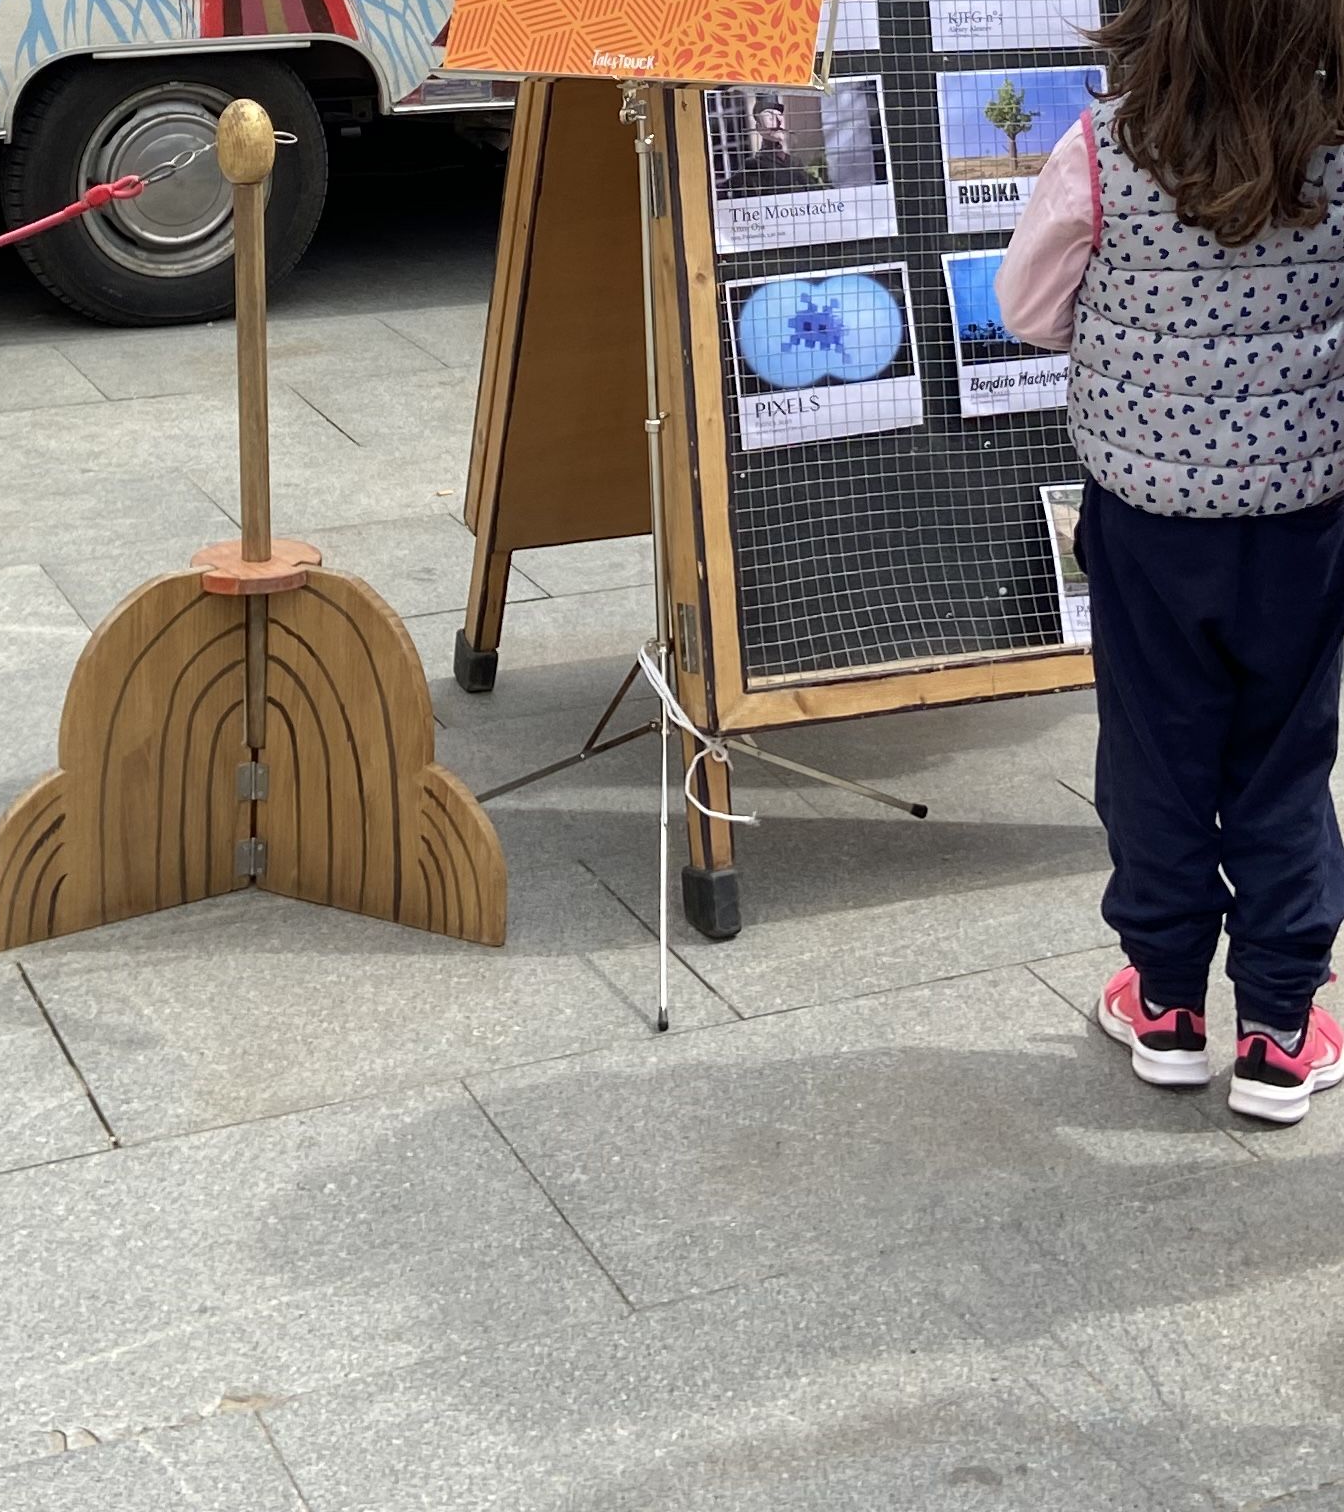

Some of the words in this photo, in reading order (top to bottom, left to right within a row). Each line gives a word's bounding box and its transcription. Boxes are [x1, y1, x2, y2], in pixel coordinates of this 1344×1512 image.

[958, 182, 1021, 205] RUBIKA
[729, 207, 761, 223] The
[764, 198, 845, 221] Moustache
[969, 375, 1016, 393] Bendito
[755, 394, 821, 419] PIXELS
